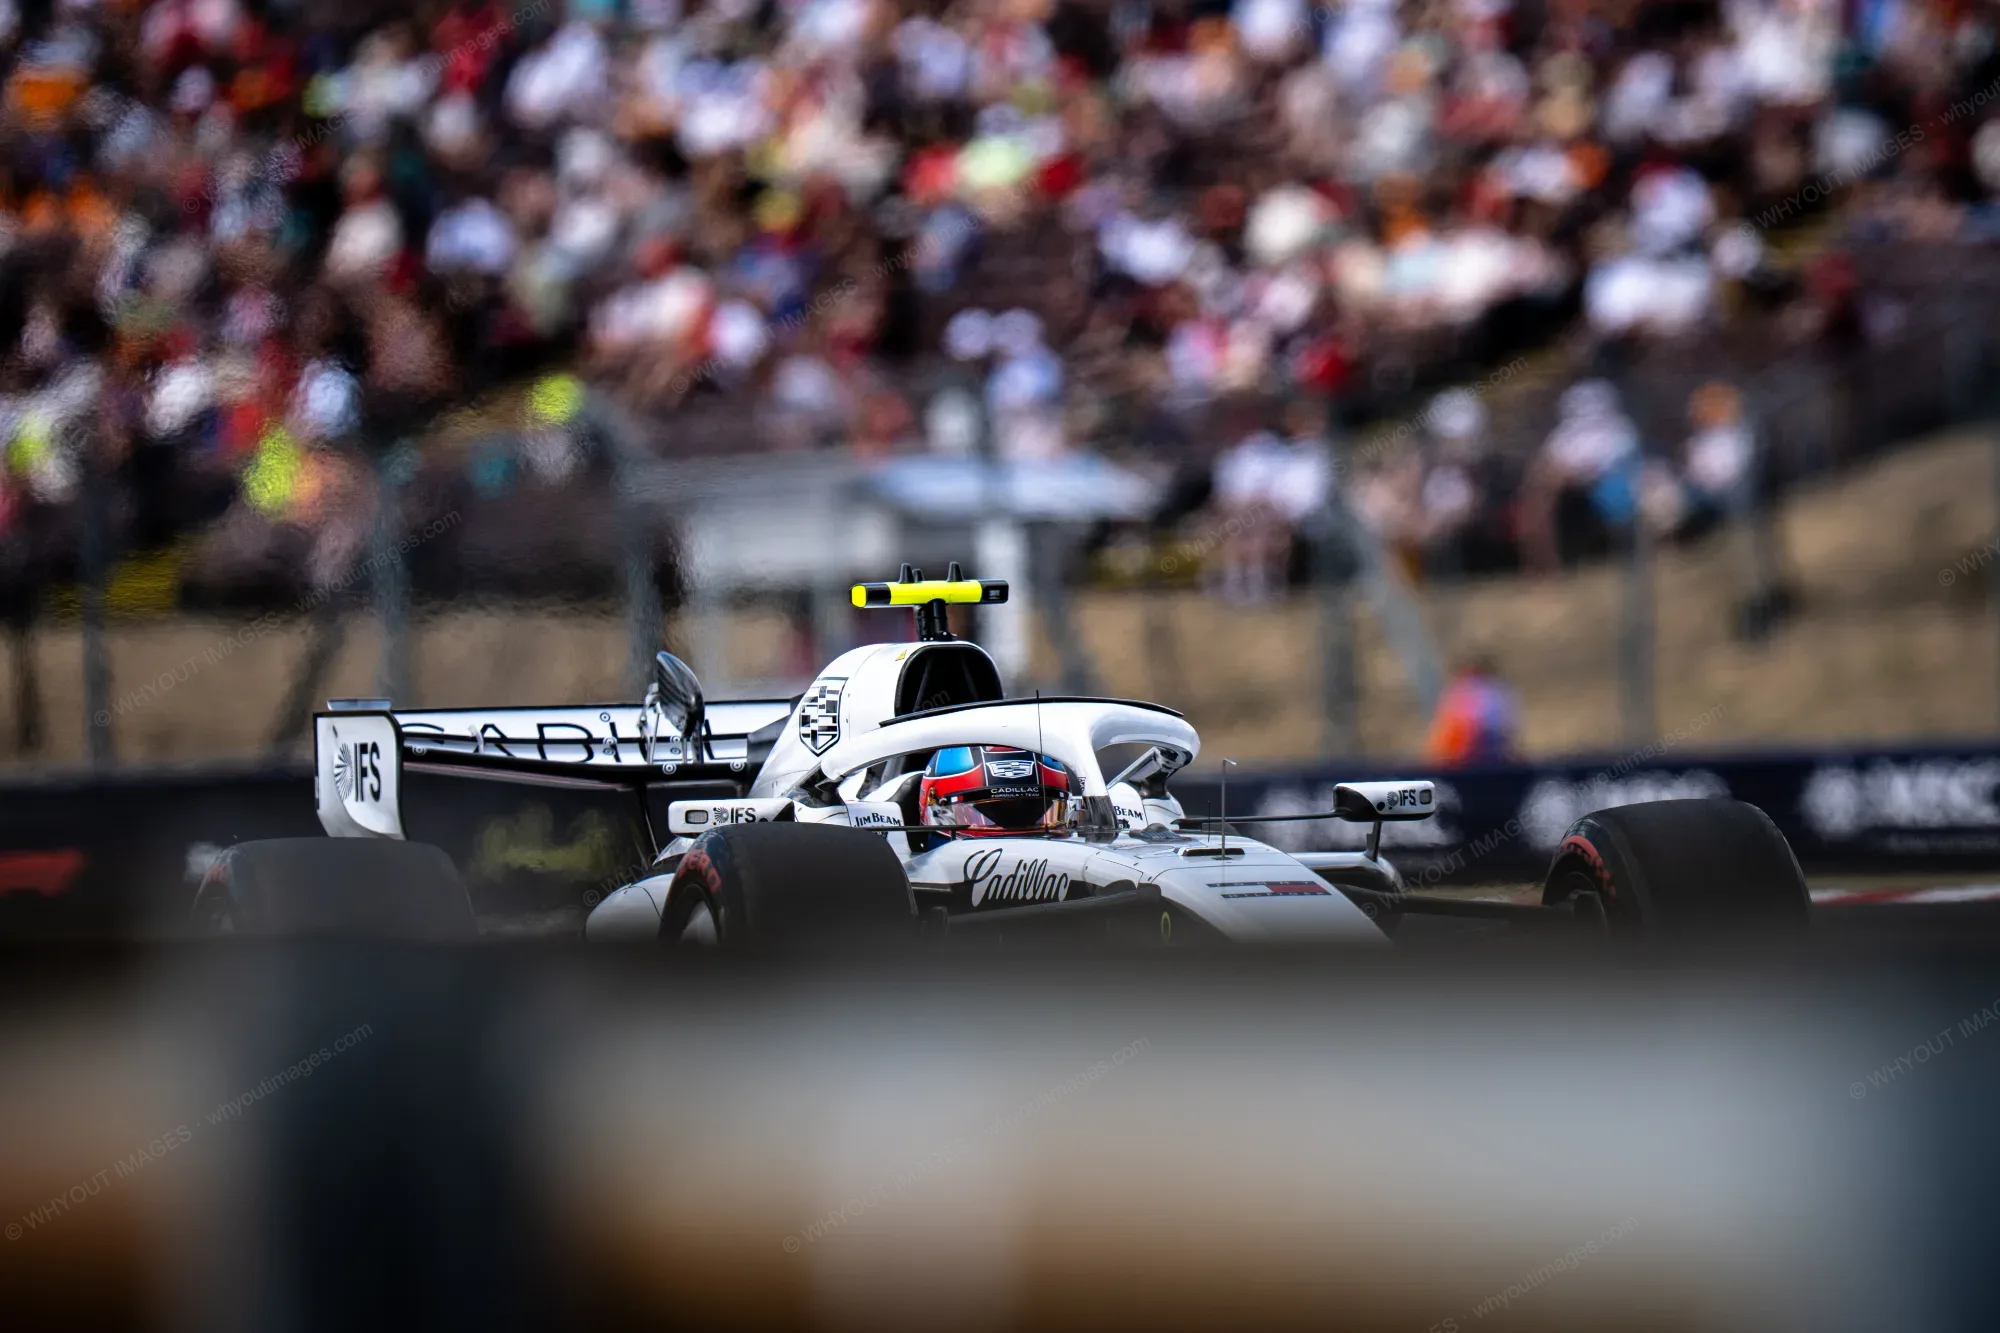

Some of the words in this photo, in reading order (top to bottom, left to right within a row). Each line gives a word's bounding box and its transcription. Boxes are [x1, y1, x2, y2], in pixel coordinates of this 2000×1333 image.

[354, 741, 381, 802] IFS
[990, 787, 1039, 795] CADILLAC
[1398, 789, 1417, 806] IFS
[731, 807, 756, 824] IFS
[854, 815, 871, 827] JIM
[871, 812, 902, 827] BEAM
[1114, 805, 1144, 821] BEAM
[963, 847, 1070, 906] Cadillac
